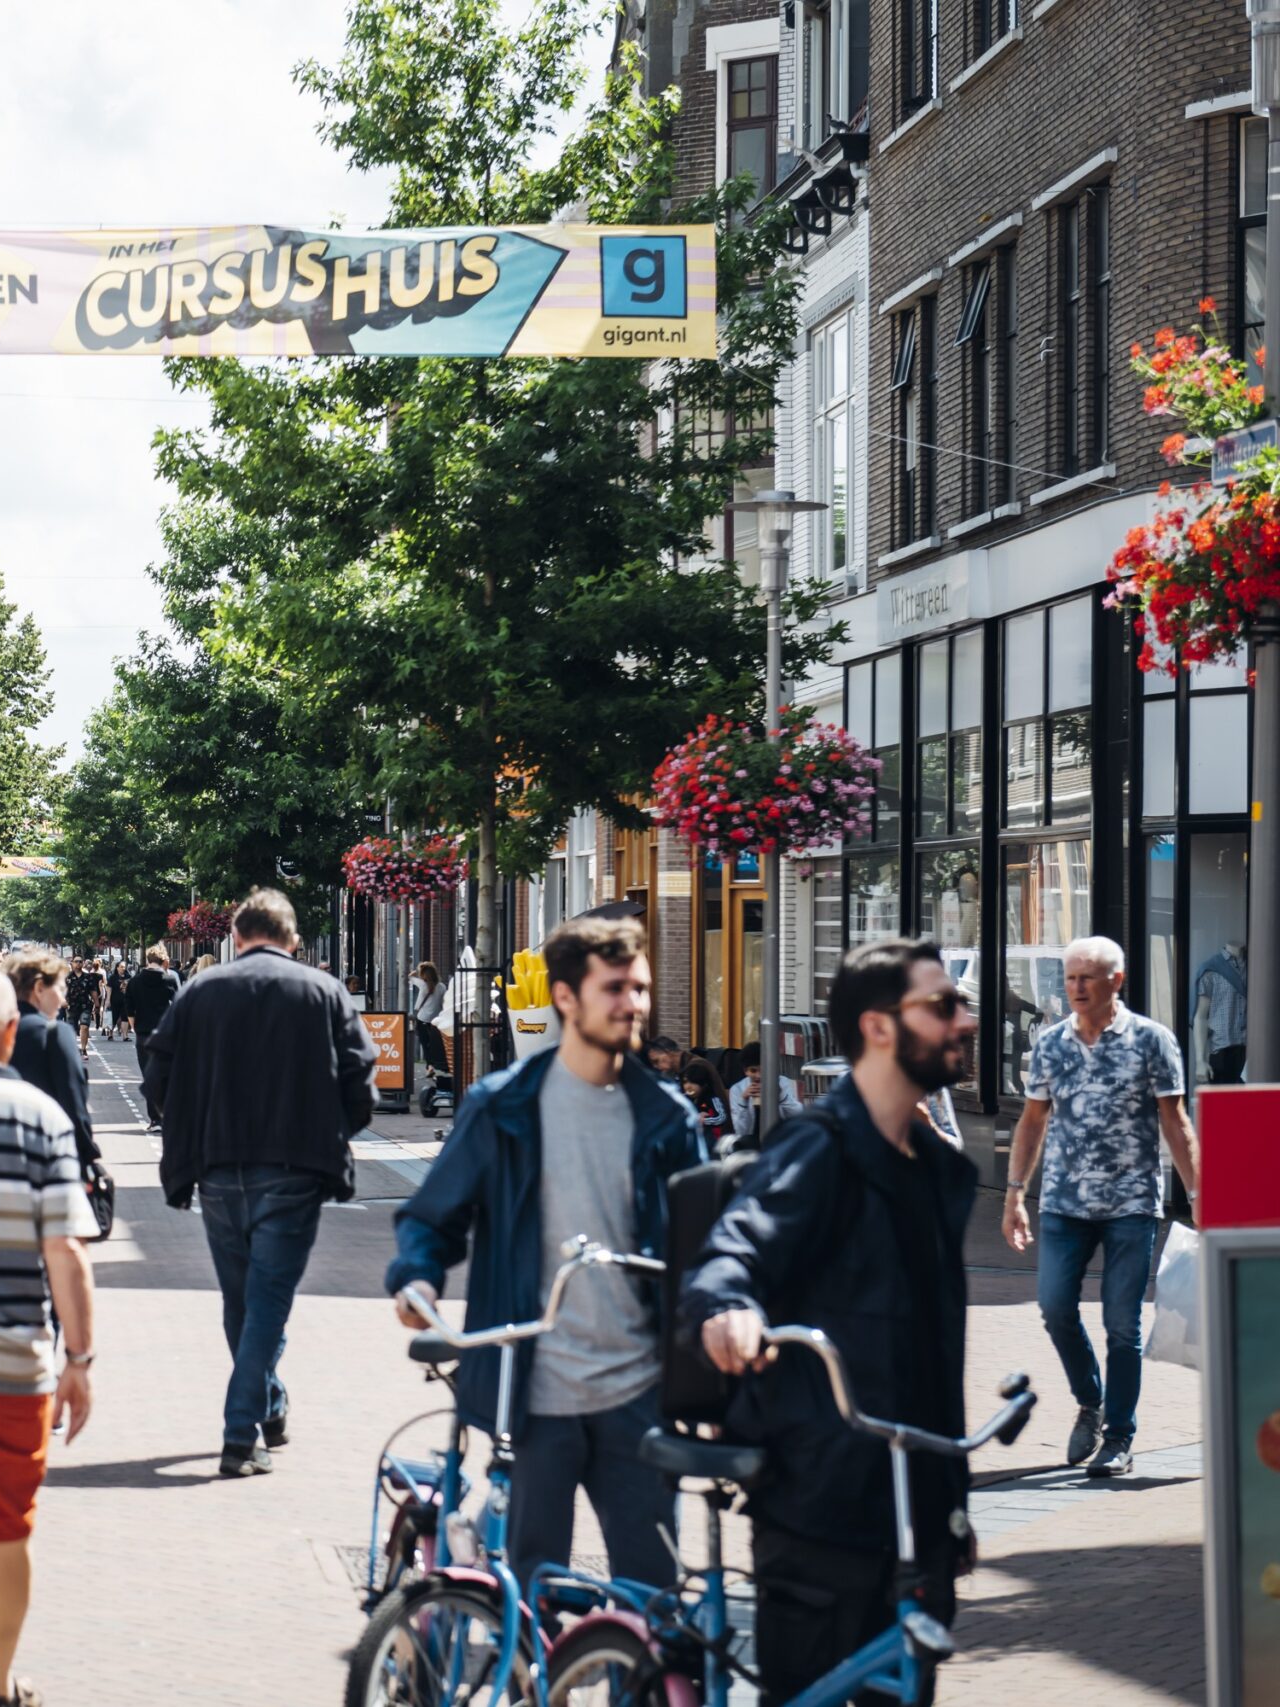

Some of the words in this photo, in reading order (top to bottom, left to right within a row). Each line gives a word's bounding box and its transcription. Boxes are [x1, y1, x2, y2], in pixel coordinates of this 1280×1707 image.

[108, 242, 134, 260] IN
[138, 237, 181, 257] HET
[622, 247, 665, 304] g
[602, 325, 687, 346] gigant.nl
